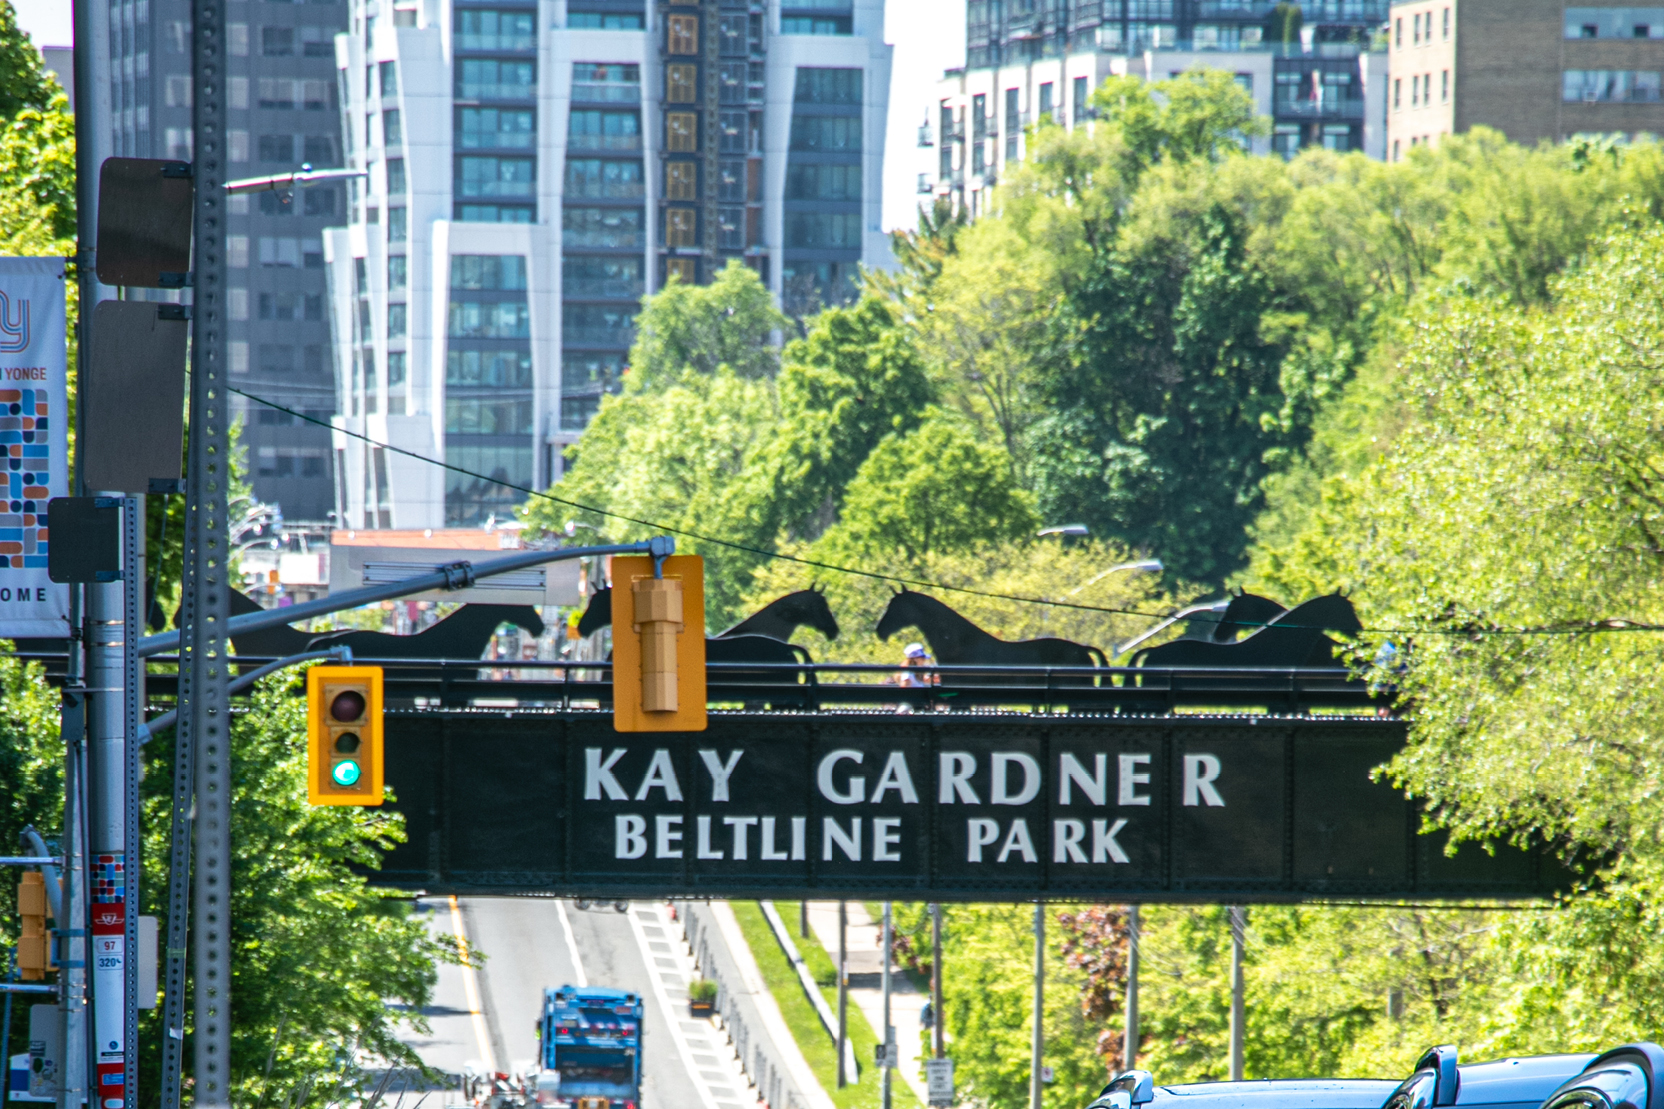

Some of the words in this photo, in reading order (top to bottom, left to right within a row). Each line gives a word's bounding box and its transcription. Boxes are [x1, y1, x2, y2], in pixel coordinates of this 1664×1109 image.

[4, 367, 47, 381] YONGE
[584, 747, 745, 802] KAY
[816, 749, 1226, 808] GARDNER
[614, 814, 901, 862] BELTLINE
[966, 817, 1131, 864] PARK
[104, 941, 116, 951] 97
[99, 958, 116, 968] 320
